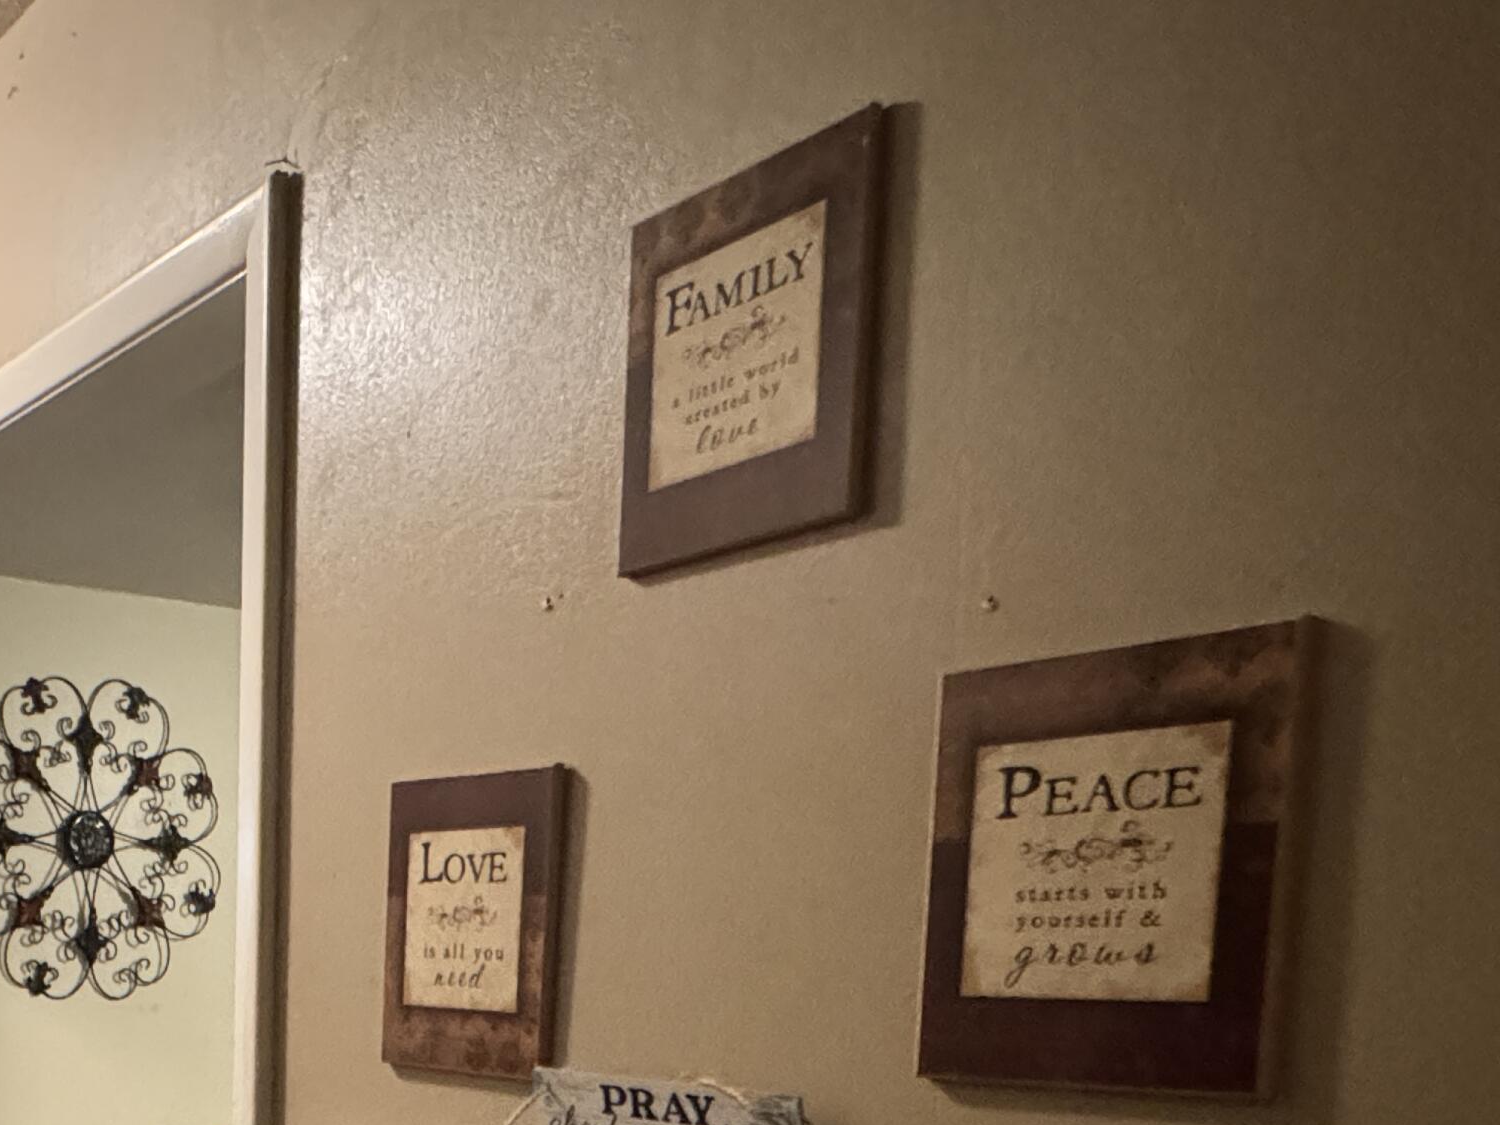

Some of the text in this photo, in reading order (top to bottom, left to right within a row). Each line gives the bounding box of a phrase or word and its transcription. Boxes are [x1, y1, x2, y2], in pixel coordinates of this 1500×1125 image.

[664, 241, 813, 337] FAMILY
[688, 370, 735, 404] little
[743, 346, 800, 380] world
[758, 379, 782, 401] by
[994, 765, 1204, 821] PEACE
[418, 841, 509, 885] LOVE
[1015, 880, 1169, 903] starts with
[1014, 909, 1163, 934] yourself &
[423, 942, 505, 966] is all you
[1004, 941, 1162, 990] grows
[434, 963, 486, 990] need
